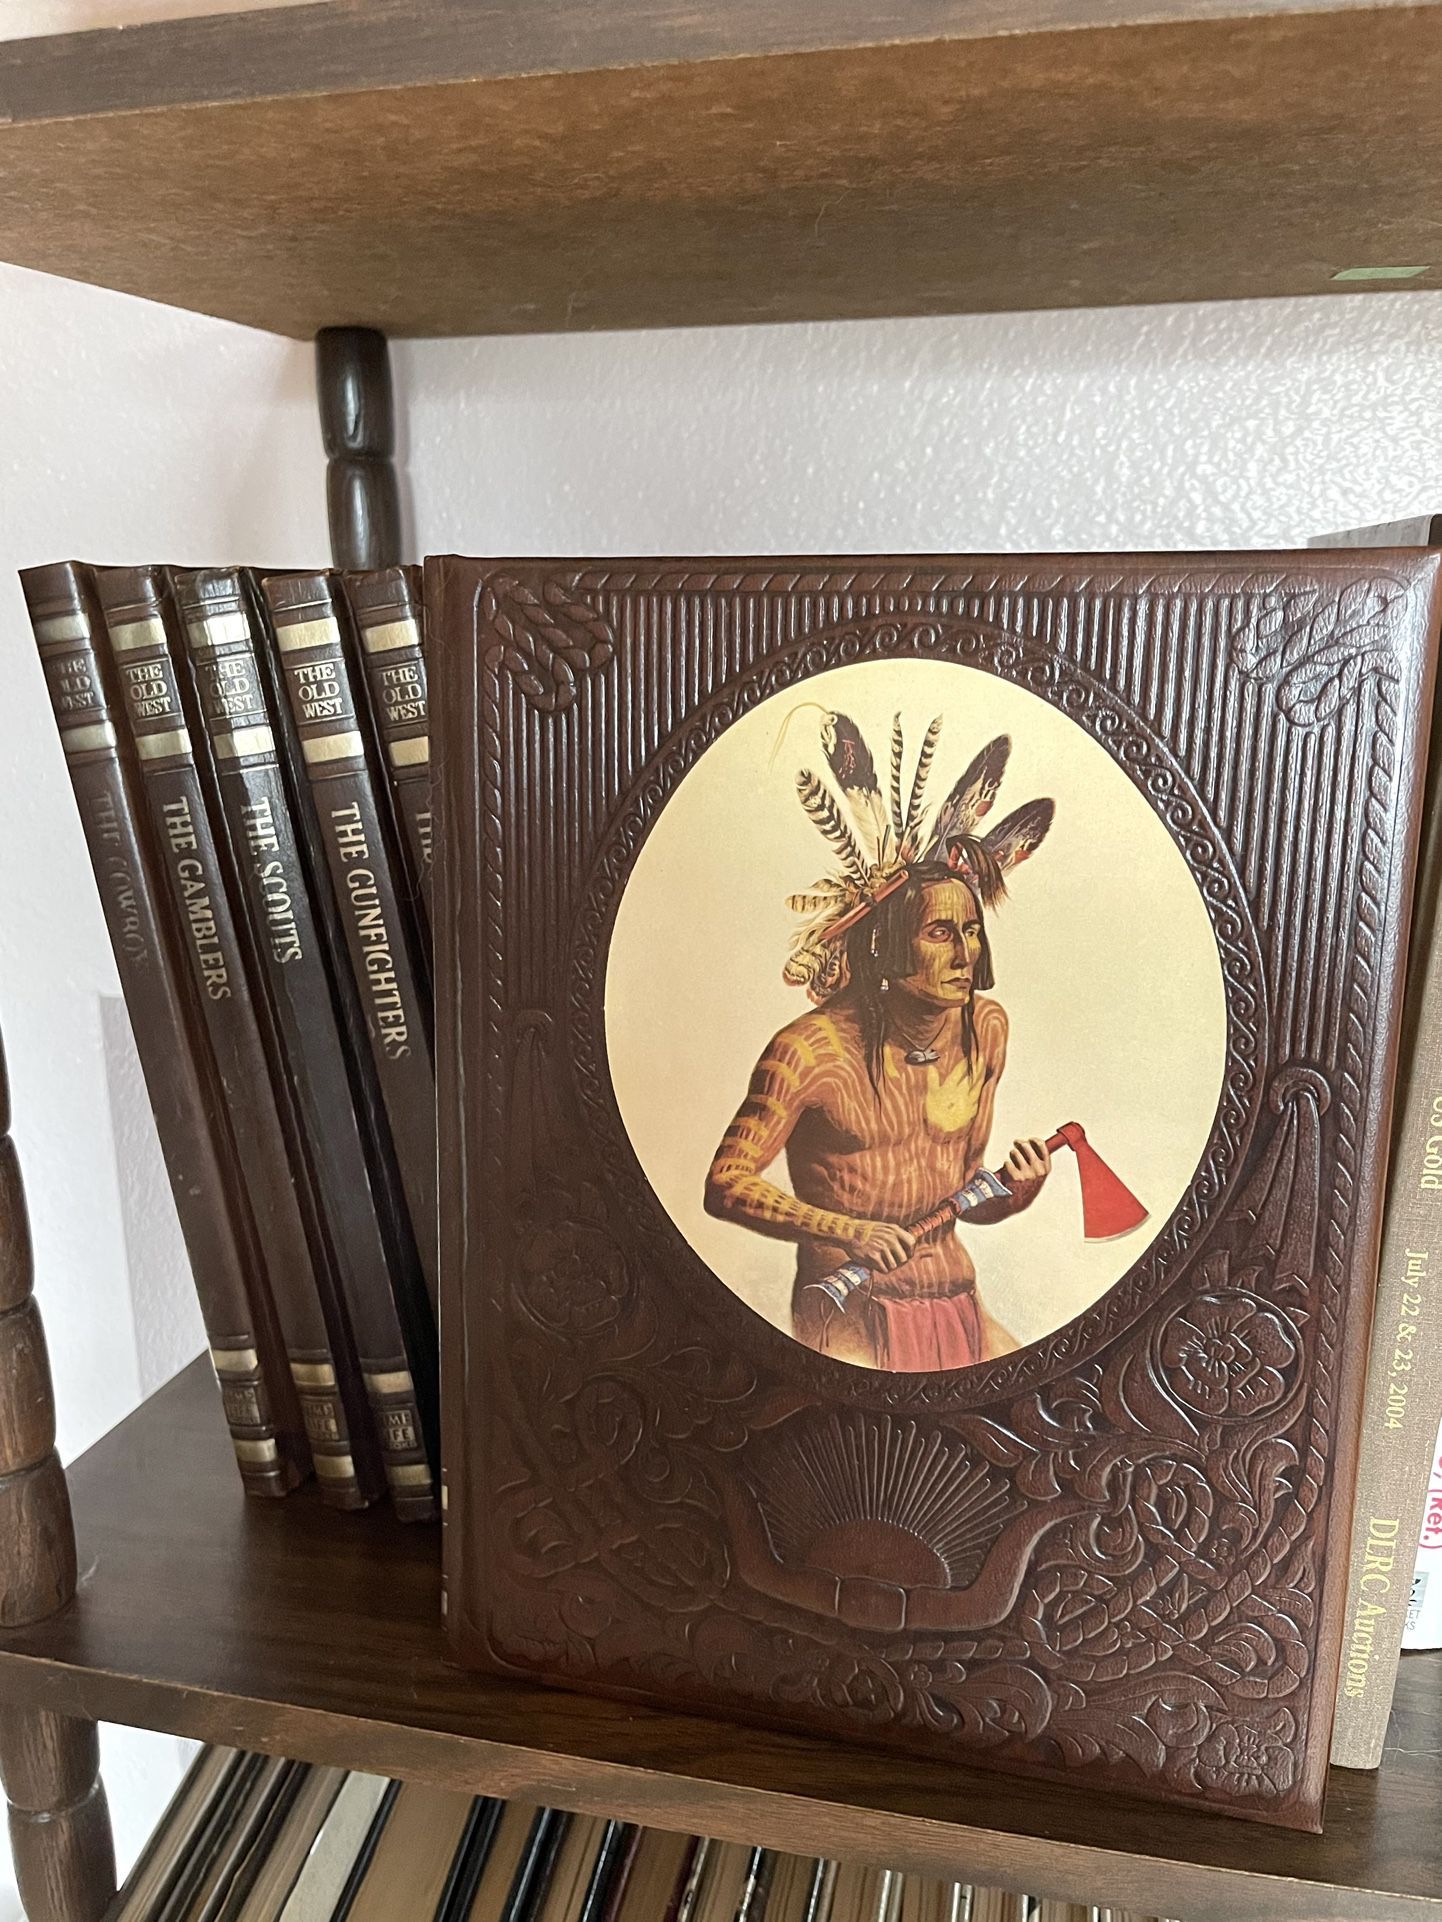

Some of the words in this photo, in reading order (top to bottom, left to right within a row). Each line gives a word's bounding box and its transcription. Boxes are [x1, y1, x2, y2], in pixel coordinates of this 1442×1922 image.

[58, 658, 87, 674] HE
[126, 663, 163, 682] THE
[205, 661, 245, 679] THE
[294, 663, 336, 684] THE
[382, 666, 419, 686] THE
[130, 680, 168, 700] OLD
[210, 677, 250, 698] OLD
[298, 681, 340, 701] OLD
[382, 683, 421, 704] OLD
[133, 697, 171, 717] WEST
[214, 694, 254, 714] WEST
[302, 700, 343, 719] WEST
[385, 700, 426, 721] WEST
[162, 796, 198, 853] THE
[241, 796, 279, 856] THE
[331, 801, 369, 862] THE
[255, 860, 303, 963] SCOUTS
[177, 858, 231, 1000] GAMBLERS
[346, 868, 411, 1060] GUNFIGHTERS
[1401, 1248, 1429, 1288] July
[1401, 1292, 1421, 1316] 22
[1396, 1322, 1417, 1341] &
[1388, 1348, 1413, 1377] 23,
[1384, 1382, 1408, 1430] 2004
[1360, 1516, 1400, 1594] DLRC
[1344, 1598, 1387, 1698] Auctions
